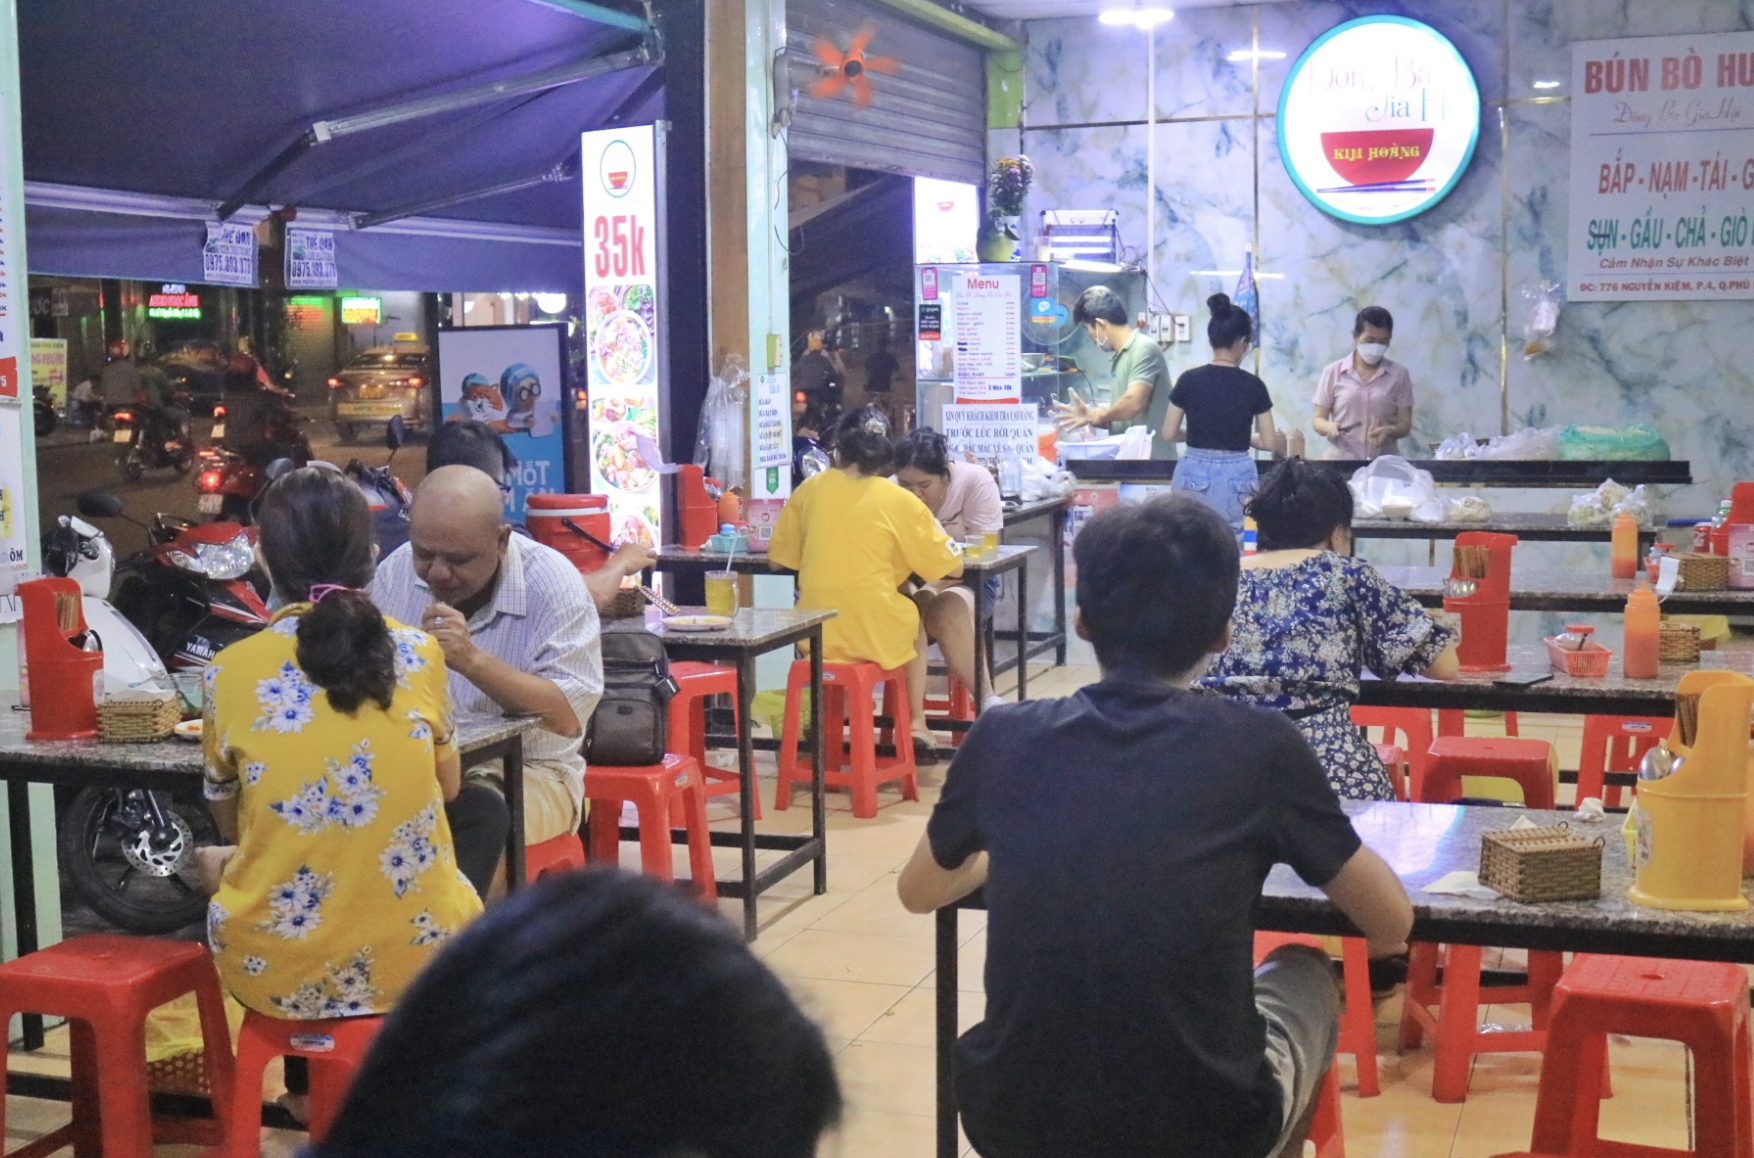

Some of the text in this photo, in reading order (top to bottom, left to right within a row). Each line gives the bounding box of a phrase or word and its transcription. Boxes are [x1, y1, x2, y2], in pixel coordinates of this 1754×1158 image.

[1584, 51, 1649, 94] BÚN
[1661, 47, 1703, 91] BÒ
[1598, 148, 1635, 194] BẮP
[1649, 161, 1689, 199] NẠM
[1675, 205, 1706, 248] CHẢ
[1720, 207, 1748, 247] GIÒ
[594, 214, 646, 278] 35k
[1599, 255, 1749, 270] Cảm Nhận Sự Khác Biệt
[967, 278, 999, 289] Menu
[1600, 283, 1618, 292] 776
[1621, 278, 1661, 291] NGUYỄN
[945, 411, 954, 421] XIN
[954, 408, 966, 423] QUÝ
[966, 408, 985, 421] KHÁCH
[945, 425, 1033, 439] TRƯỚC LÚC RỜI QUÁN
[186, 641, 217, 659] YAMAH
